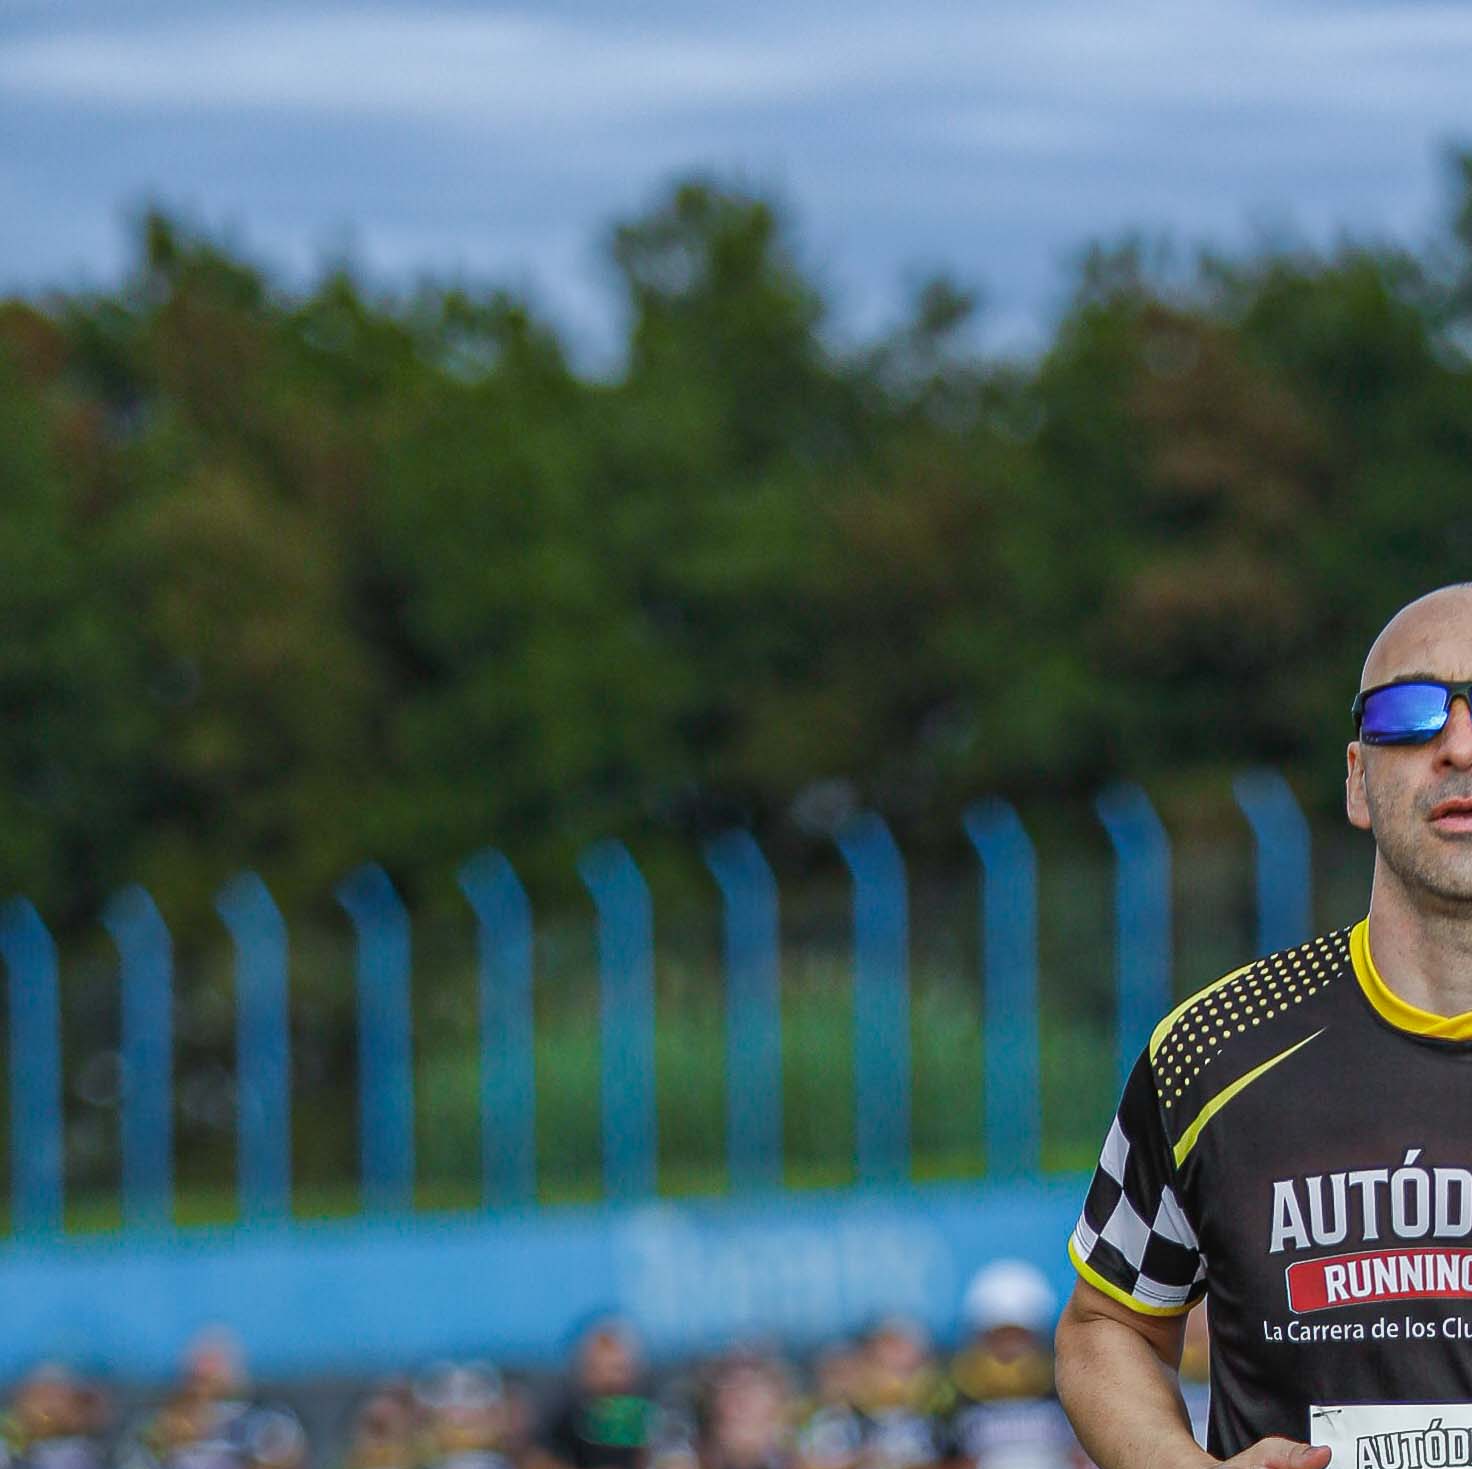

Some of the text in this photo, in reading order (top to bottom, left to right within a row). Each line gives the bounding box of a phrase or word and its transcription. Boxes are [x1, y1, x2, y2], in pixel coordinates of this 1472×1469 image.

[1263, 1320, 1283, 1341] La
[1287, 1320, 1365, 1342] Carrera
[1371, 1317, 1399, 1339] de
[1405, 1316, 1436, 1338] los
